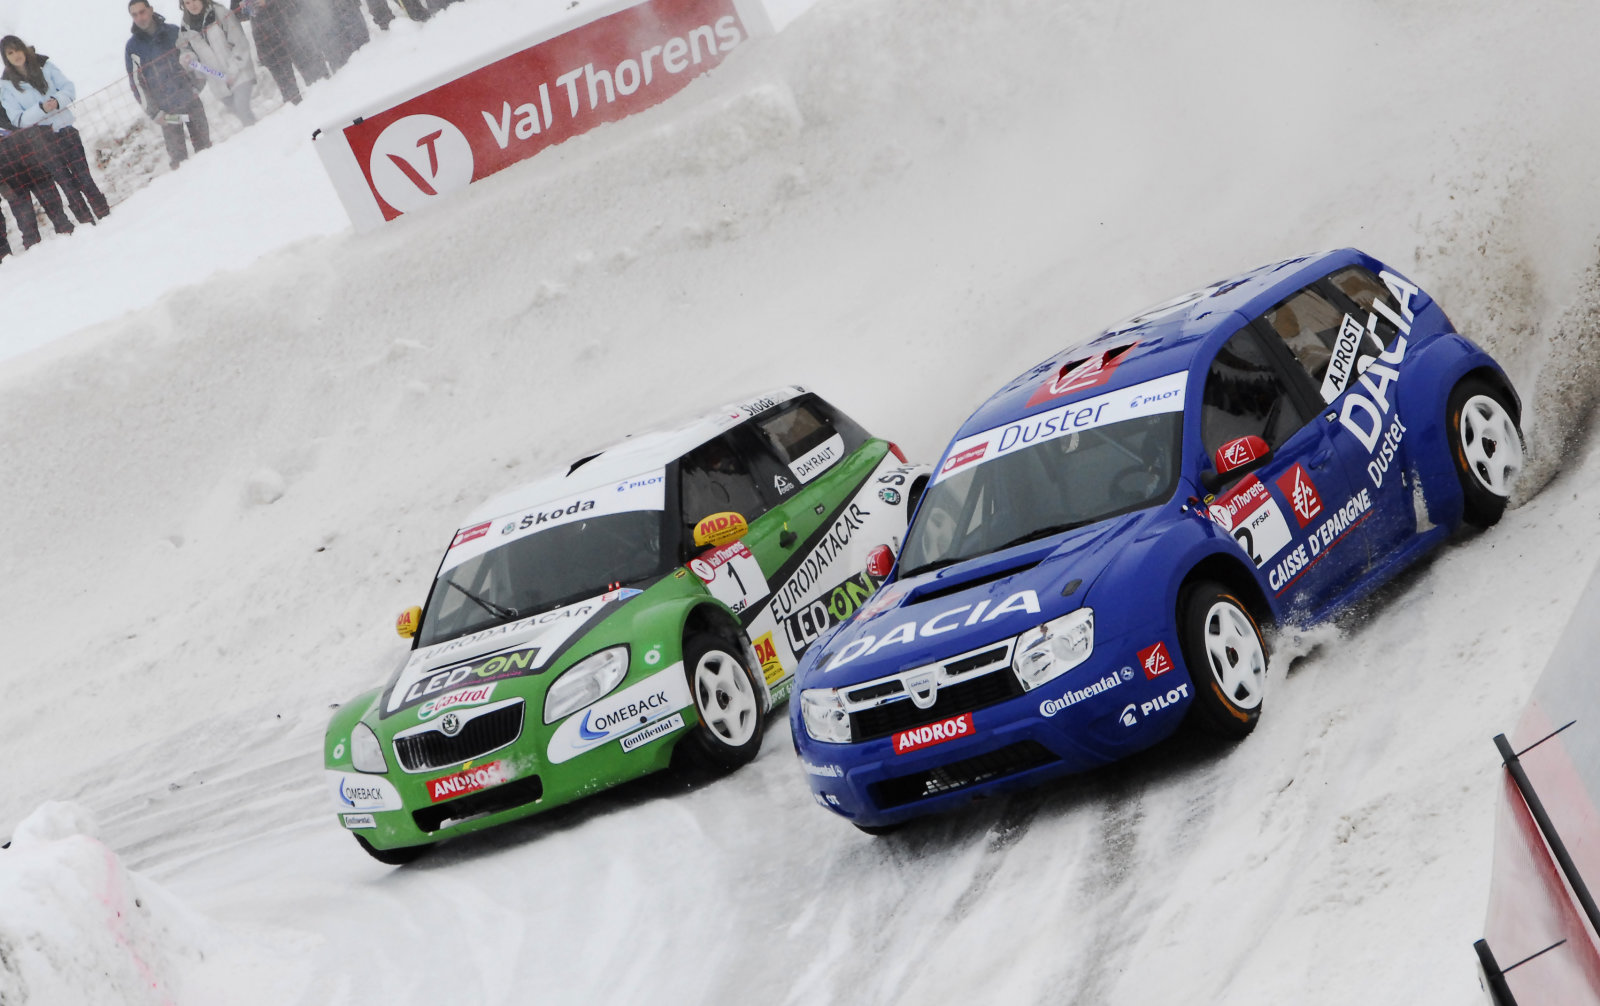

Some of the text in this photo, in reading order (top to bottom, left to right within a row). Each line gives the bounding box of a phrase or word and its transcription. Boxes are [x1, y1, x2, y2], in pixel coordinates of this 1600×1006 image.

[481, 14, 741, 150] Val Thorens
[1329, 318, 1361, 391] A.PROST
[1339, 270, 1419, 455] DACIA
[1143, 389, 1181, 405] PILOT
[998, 402, 1110, 453] Duster
[797, 446, 835, 477] DAYRAUT
[1367, 413, 1407, 488] Duster
[629, 476, 664, 490] PILOT
[1233, 480, 1265, 510] Thorens
[519, 499, 596, 531] Škoda
[700, 514, 742, 536] MDA
[716, 541, 745, 562] Thorens
[1233, 526, 1263, 566] 2
[1268, 487, 1372, 591] CAISSE D'EPARGNE
[727, 561, 747, 596] 1
[769, 503, 871, 625] EURODATACAR
[824, 589, 1041, 673] DACIA
[753, 637, 777, 665] DA
[433, 686, 491, 712] Castrol
[1039, 671, 1123, 718] Continental
[1140, 682, 1189, 717] PILOT
[623, 720, 673, 749] Continental
[898, 715, 968, 751] ANDROS
[433, 764, 502, 799] ANDROS
